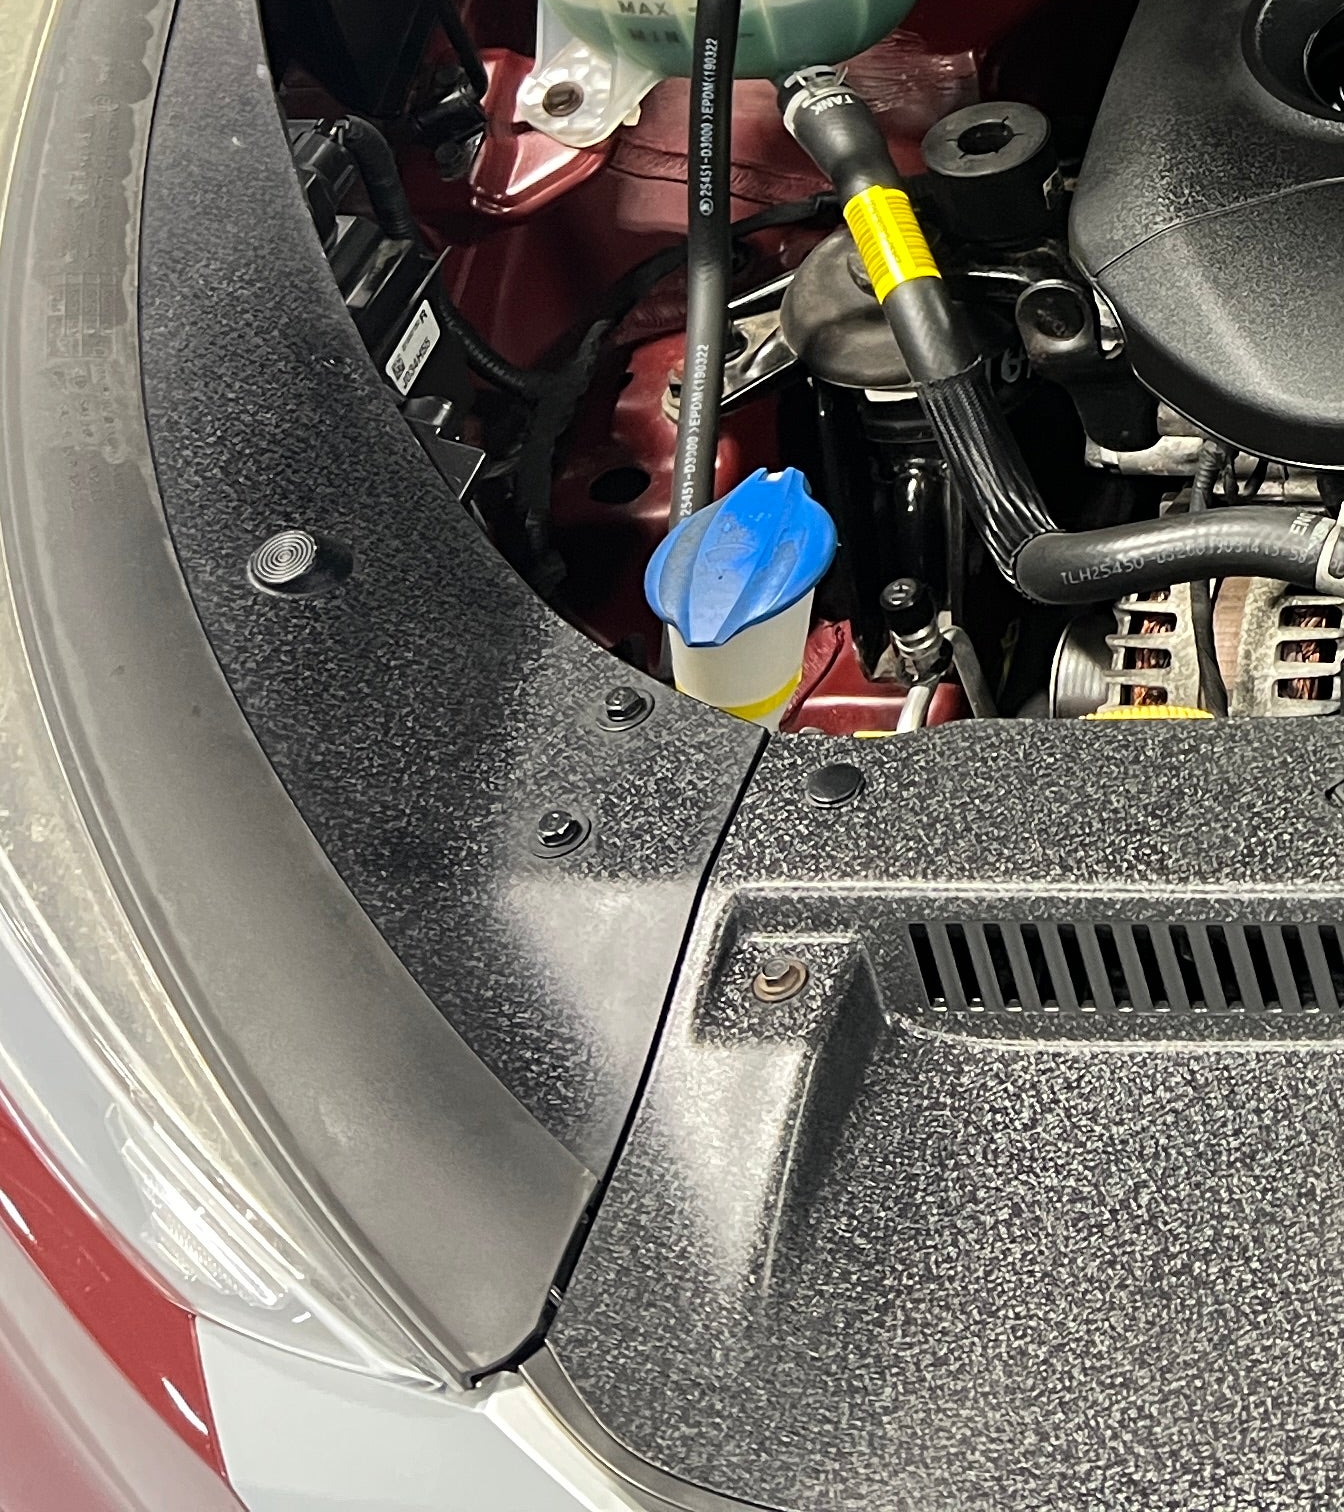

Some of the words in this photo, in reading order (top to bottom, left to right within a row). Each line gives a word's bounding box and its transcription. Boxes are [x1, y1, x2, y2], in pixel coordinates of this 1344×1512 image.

[617, 0, 669, 16] MAX
[629, 27, 680, 44] MIN
[810, 93, 855, 116] TANK
